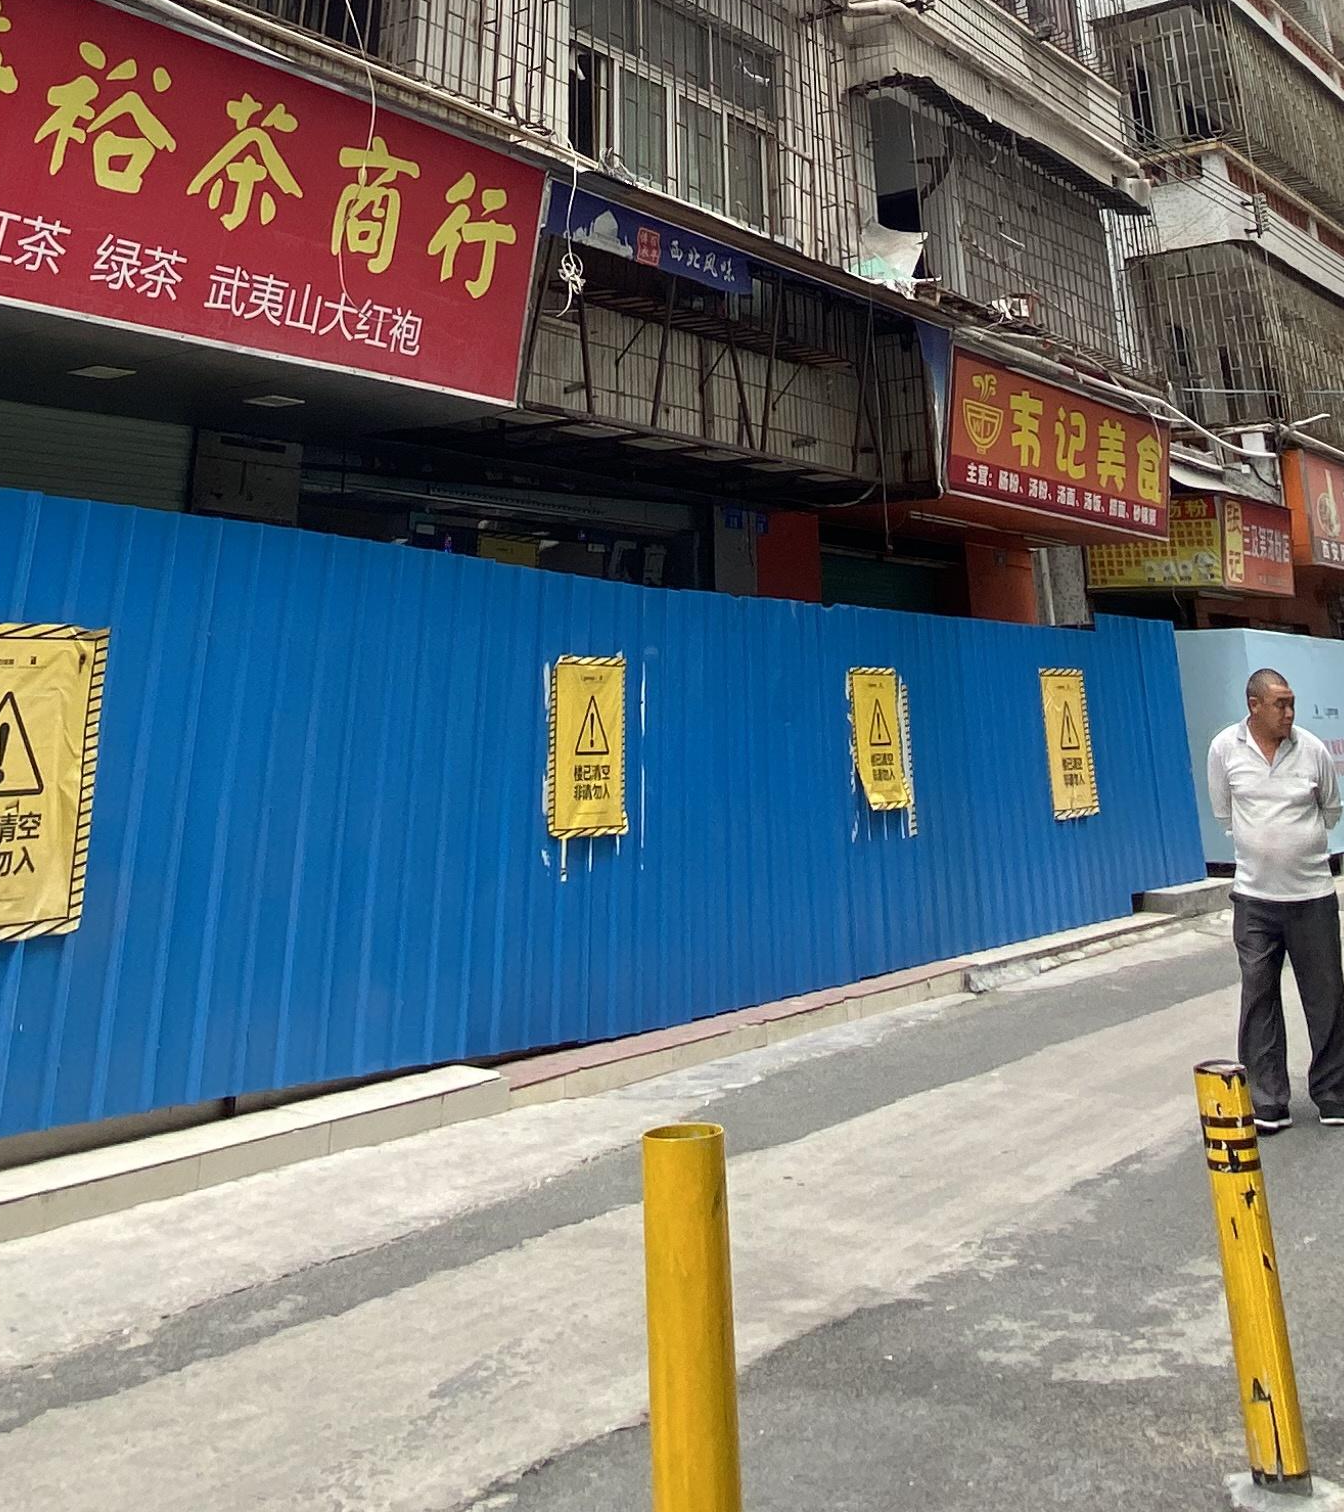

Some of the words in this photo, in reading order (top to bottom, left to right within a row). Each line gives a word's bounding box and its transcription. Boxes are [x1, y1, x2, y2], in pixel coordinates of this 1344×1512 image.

[670, 239, 736, 283] 西北风味
[89, 233, 189, 303] 绿茶
[203, 263, 423, 358] 武夷山大红袍
[1009, 389, 1164, 504] 韦记美食
[573, 764, 611, 781] 楼已清空
[573, 783, 611, 801] 非请勿入
